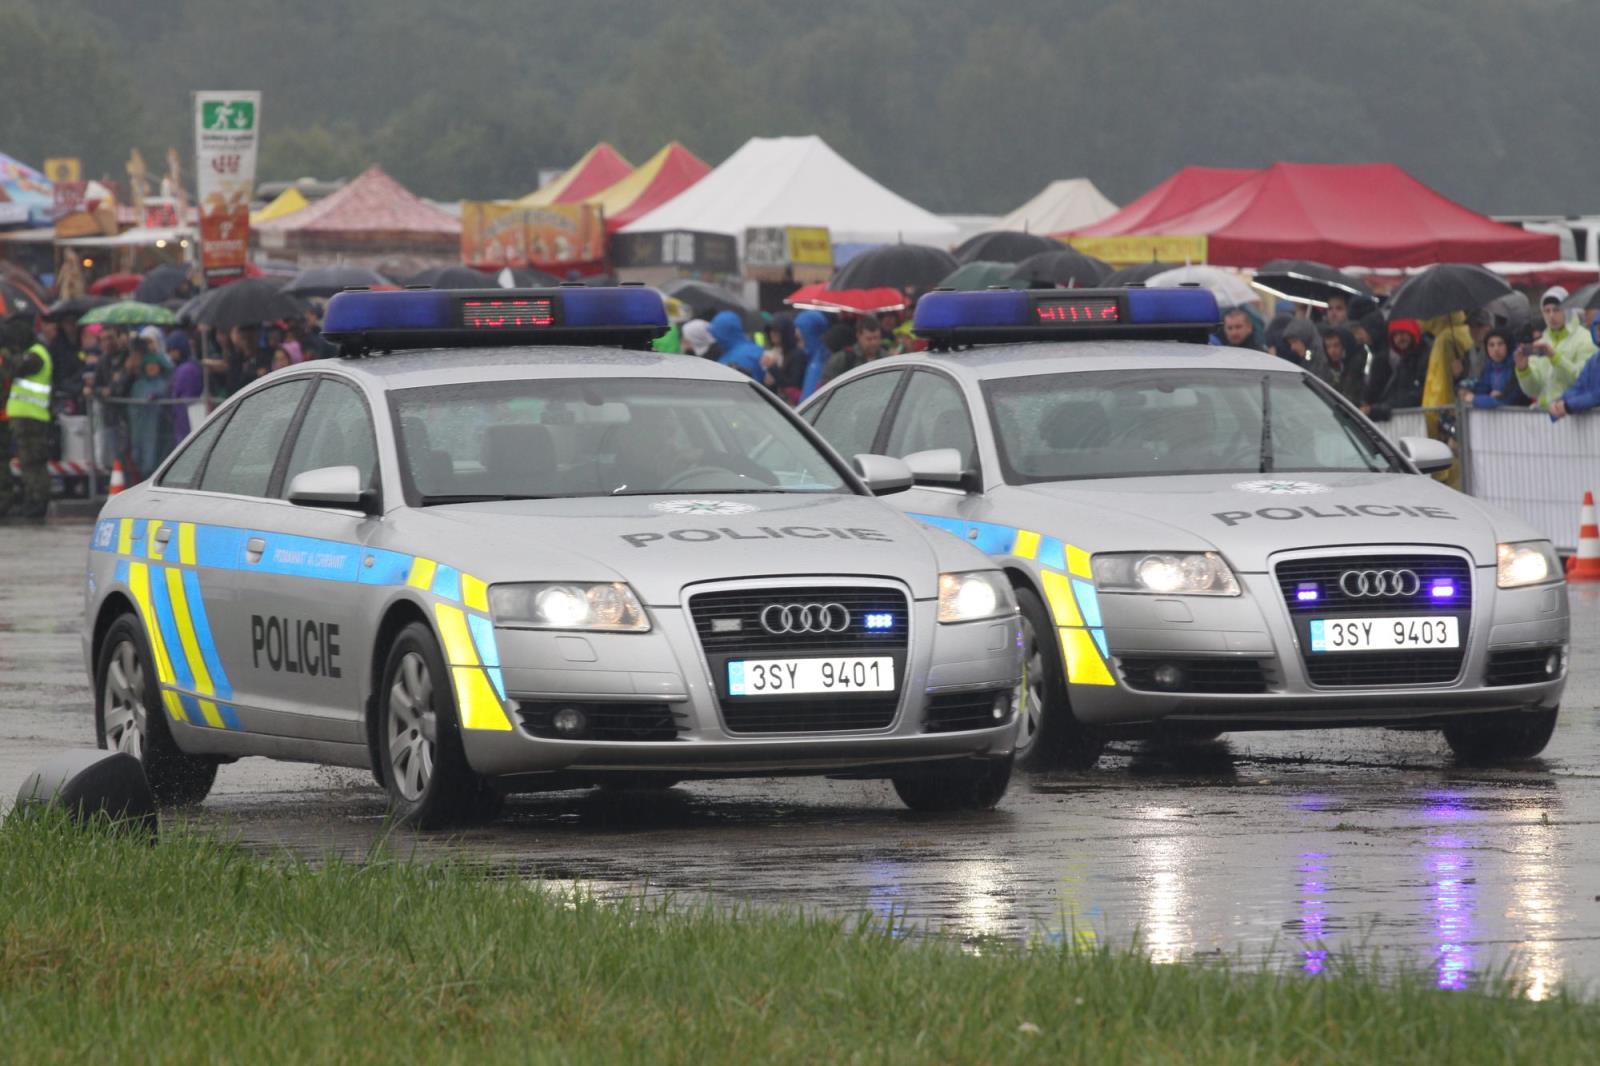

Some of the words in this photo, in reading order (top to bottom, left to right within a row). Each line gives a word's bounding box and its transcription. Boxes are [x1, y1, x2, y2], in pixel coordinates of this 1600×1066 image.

[1211, 503, 1458, 527] POLICIE
[620, 525, 893, 548] POLICIE
[252, 614, 341, 679] POLICIE
[1332, 622, 1373, 647] 3SY
[1393, 620, 1447, 645] 9403
[752, 663, 798, 690] 3SY
[821, 660, 881, 688] 9401
